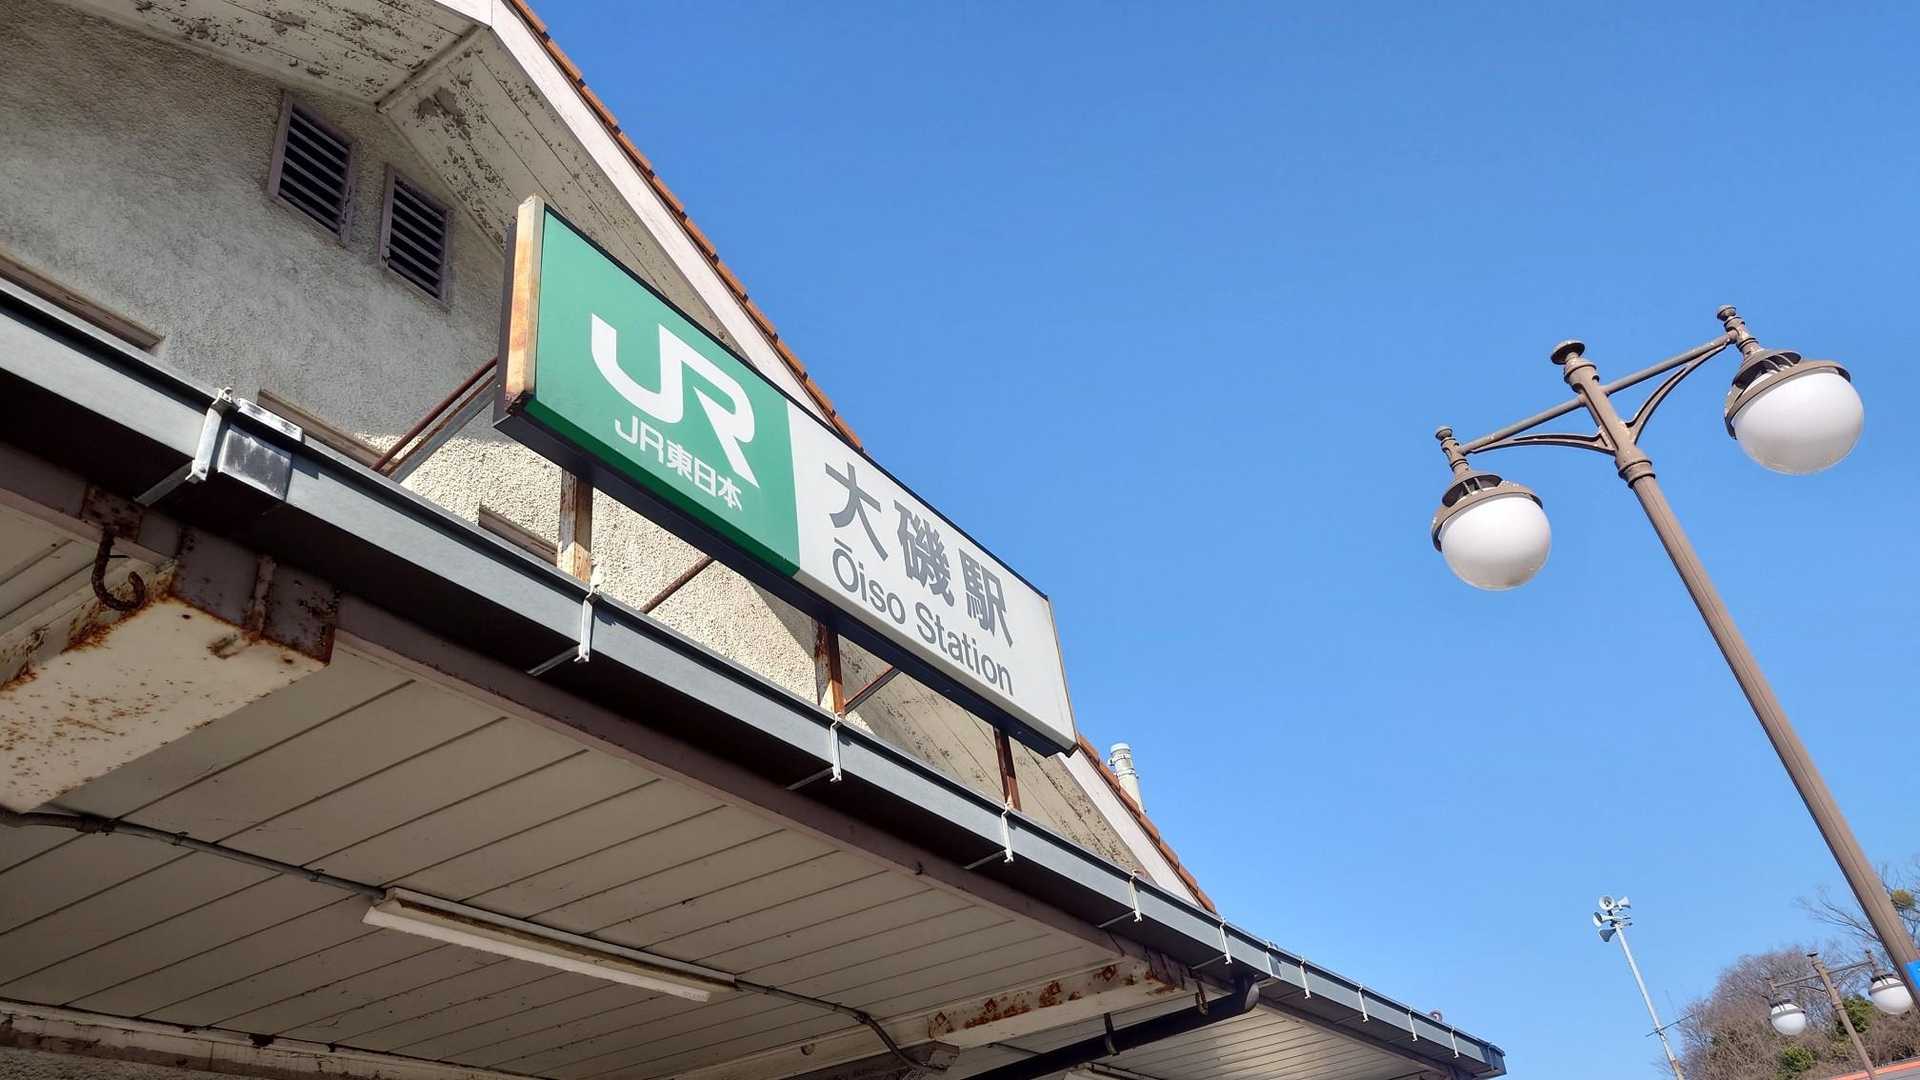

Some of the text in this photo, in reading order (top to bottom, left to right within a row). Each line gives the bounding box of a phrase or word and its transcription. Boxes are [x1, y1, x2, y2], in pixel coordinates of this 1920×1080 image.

[592, 313, 759, 488] JR
[615, 416, 742, 511] JR東日本
[825, 462, 1013, 647] 大磯駅
[832, 538, 1014, 695] Ōiso Station
